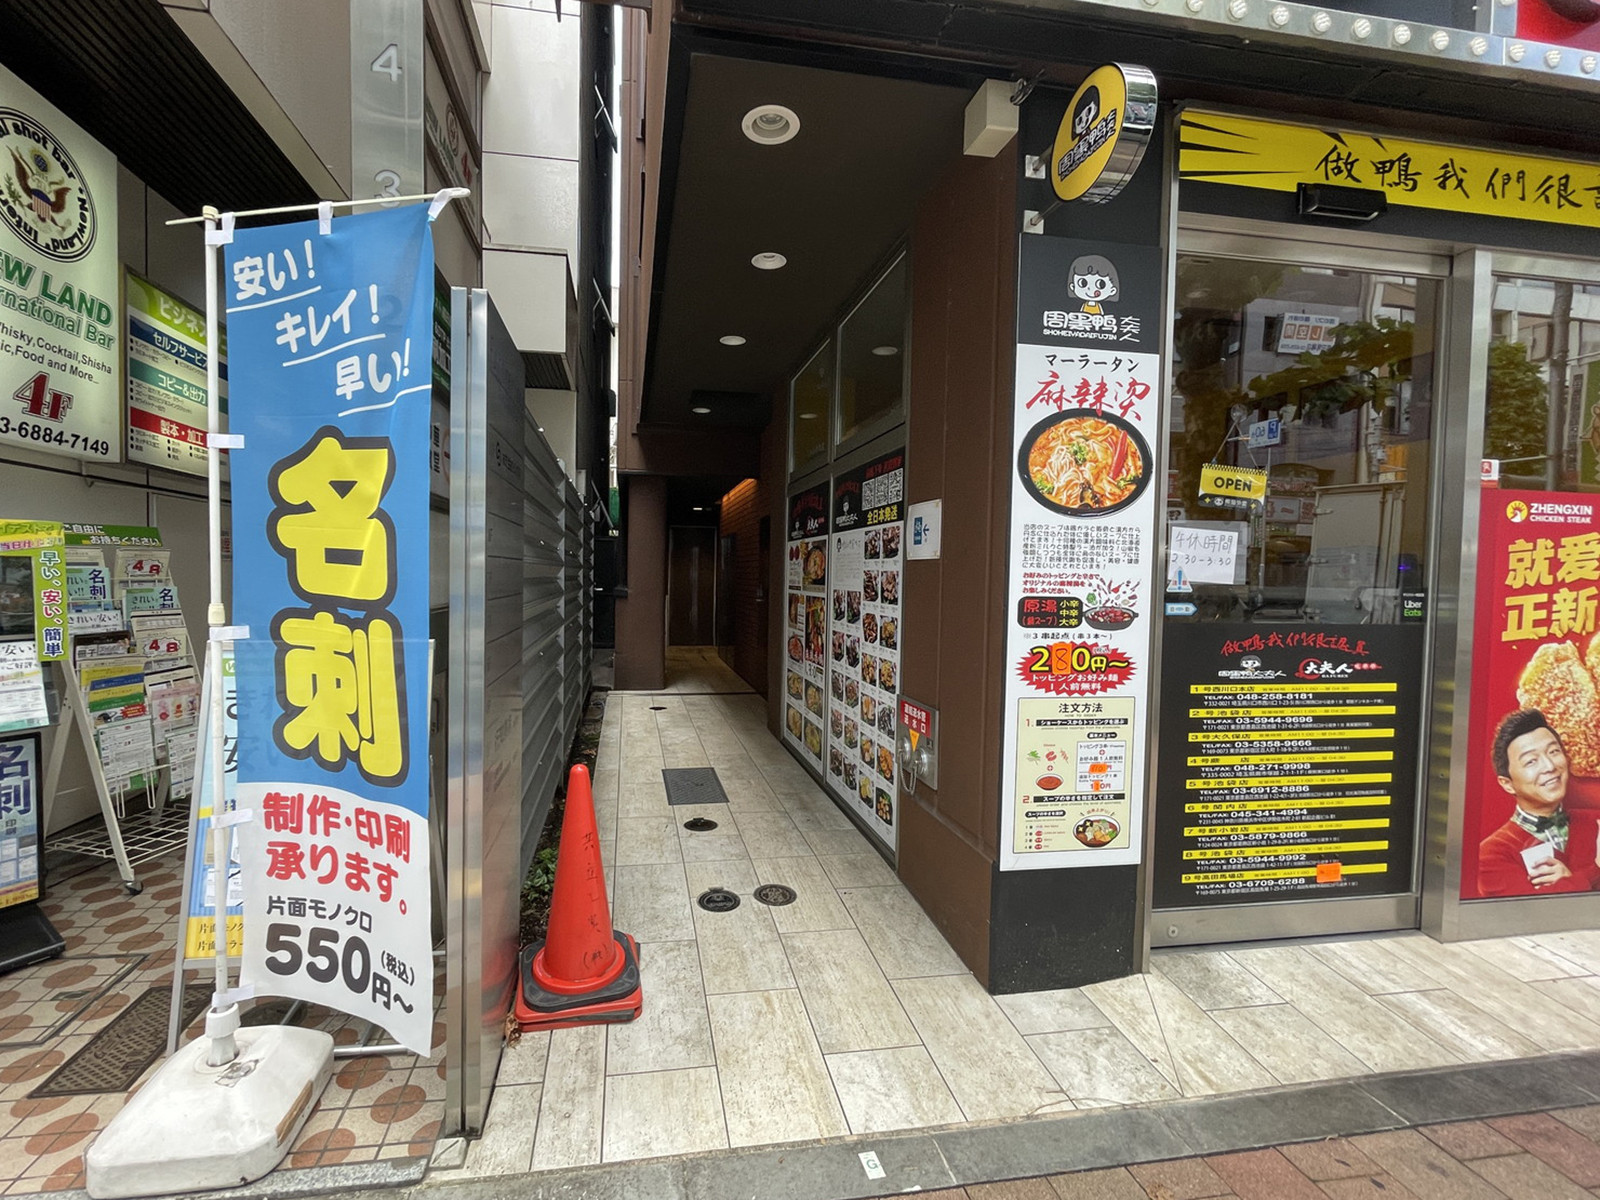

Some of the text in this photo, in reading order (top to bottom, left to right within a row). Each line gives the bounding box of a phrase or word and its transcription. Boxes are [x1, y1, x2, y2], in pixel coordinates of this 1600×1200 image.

[371, 43, 402, 82] 4
[12, 121, 48, 151] shot
[51, 145, 76, 181] bar
[374, 171, 401, 208] 3
[41, 272, 113, 329] LAND
[85, 323, 115, 350] Bar
[0, 322, 112, 375] hisky,Cocktail,Shisha
[48, 358, 67, 373] and
[1045, 354, 1139, 372] マーラータン
[13, 371, 74, 423] 4F
[1214, 477, 1252, 492] OPEN
[1530, 503, 1592, 515] ZHENGXIN
[1567, 516, 1591, 524] STEAK
[91, 536, 161, 546] お持ちください
[1176, 531, 1233, 553] 午休時間
[1505, 532, 1600, 588] 就爱
[89, 569, 108, 600] 名刺
[270, 430, 408, 784] 名刺
[1404, 600, 1422, 609] Uber
[1060, 609, 1079, 617] 中辛
[1501, 586, 1598, 641] 正新
[1059, 618, 1079, 626] 大辛
[1059, 703, 1103, 713] 注文方法
[1234, 740, 1312, 748] 03-5358-9666
[1233, 763, 1311, 771] 048-271-9998
[1232, 785, 1310, 794] 03-6912-8886
[1230, 809, 1308, 818] 045-341-4994
[263, 791, 410, 863] 制作・印刷
[1229, 832, 1307, 841] 03-5879-9866
[1228, 854, 1306, 864] 03-5944-9992
[266, 841, 407, 915] 承ります。
[1228, 878, 1305, 888] 03-6709-6288
[266, 895, 372, 933] 片面モノクロ
[866, 1159, 879, 1170] G
